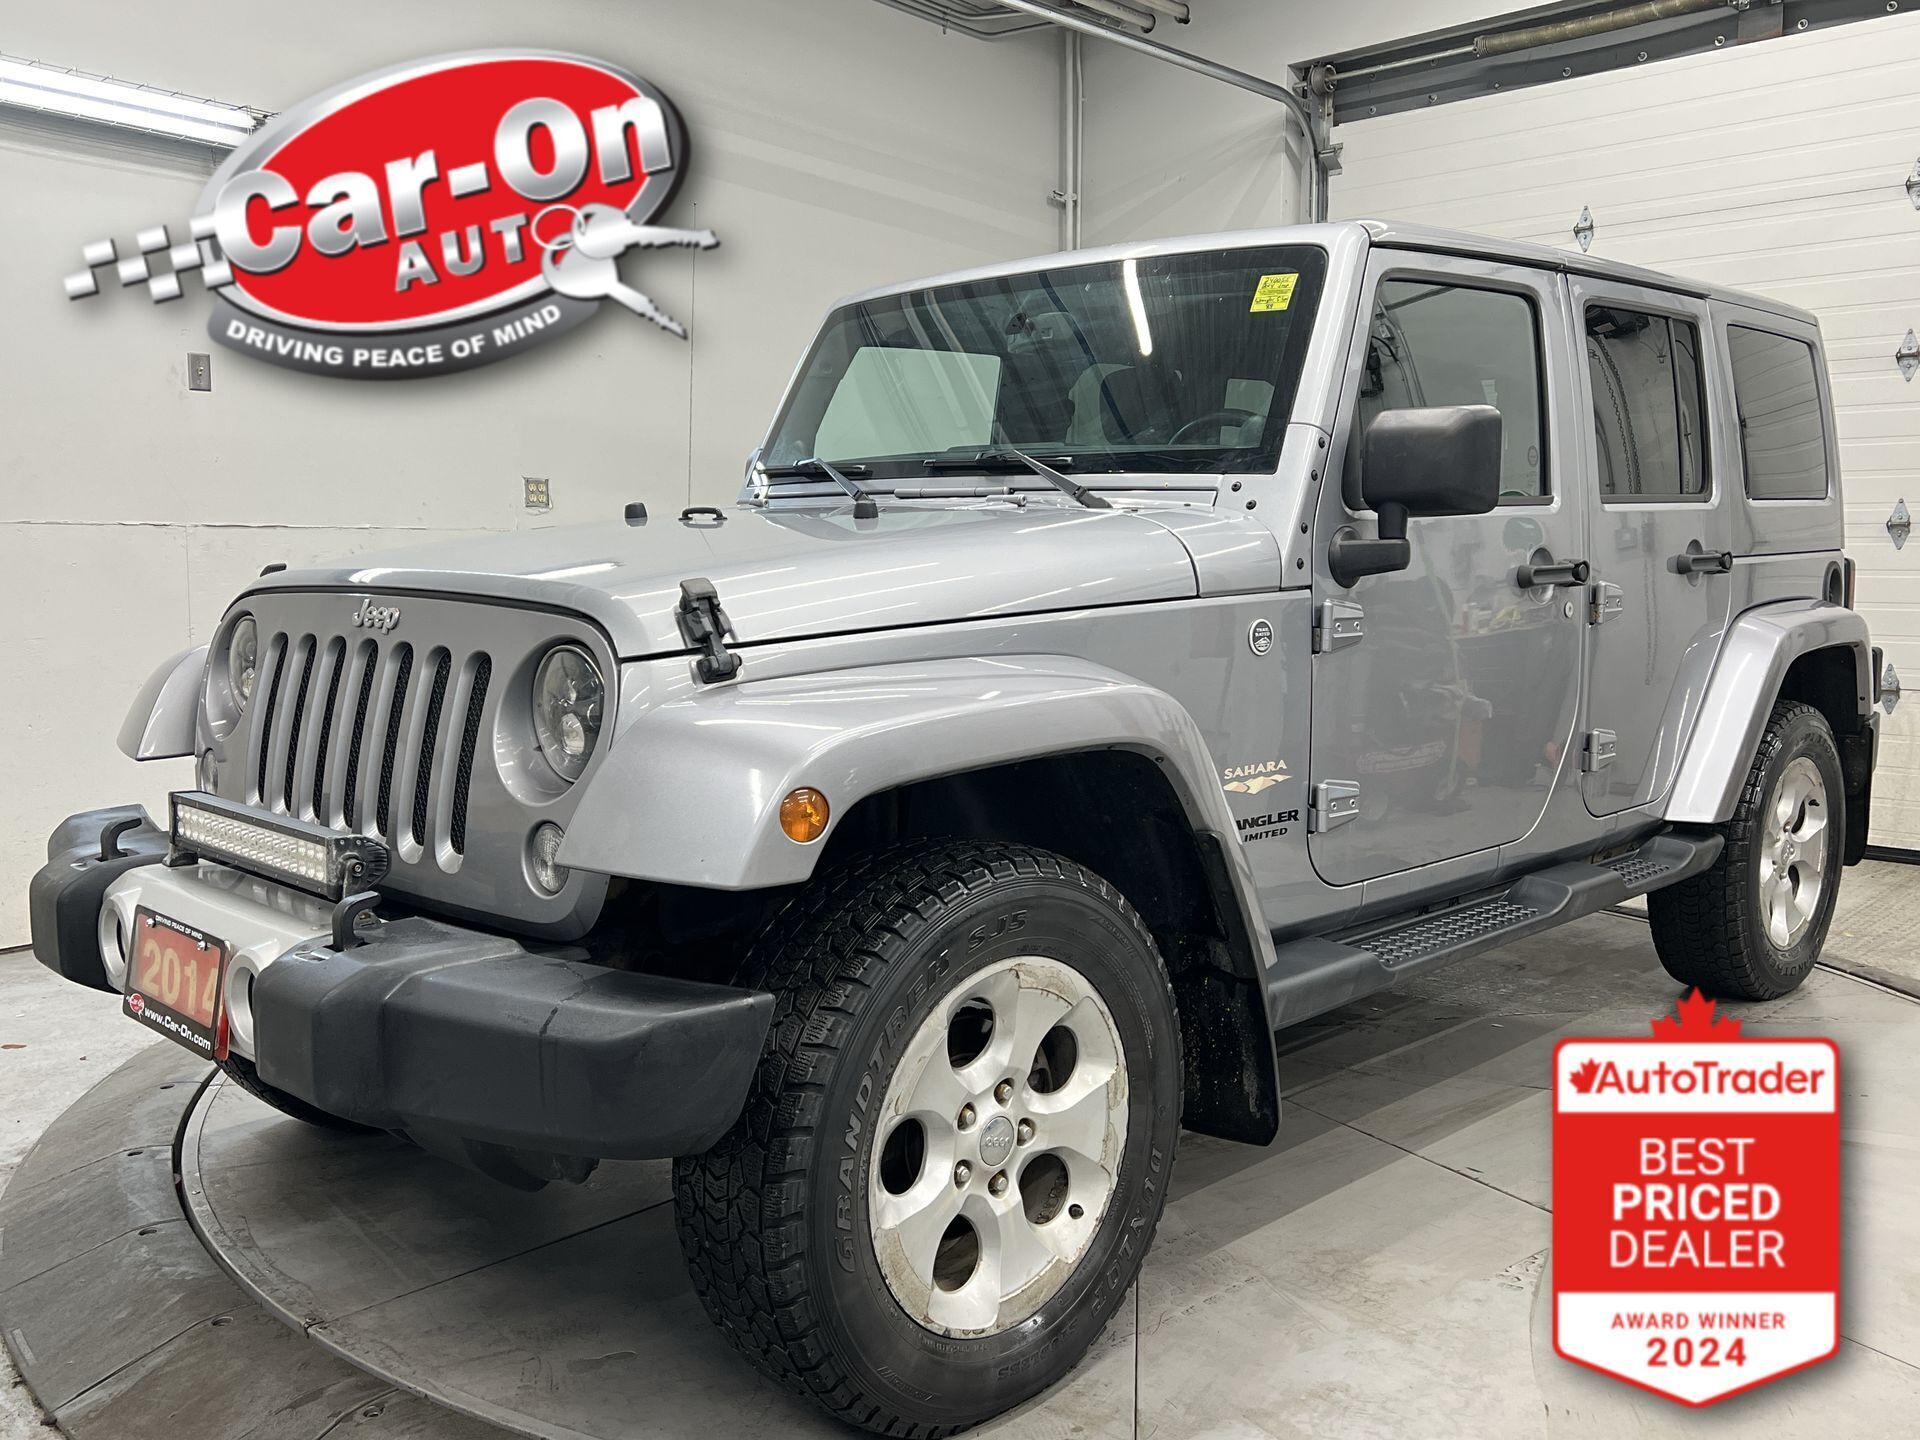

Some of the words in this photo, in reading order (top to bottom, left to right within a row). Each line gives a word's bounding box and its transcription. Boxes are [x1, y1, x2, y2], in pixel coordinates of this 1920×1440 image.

[351, 598, 400, 635] Jeep
[1223, 759, 1288, 780] SAHARA
[1235, 809, 1300, 831] ANGLER
[1244, 827, 1288, 842] IMITED
[142, 938, 219, 1013] 2014
[144, 1007, 212, 1051] www.Car-On.com
